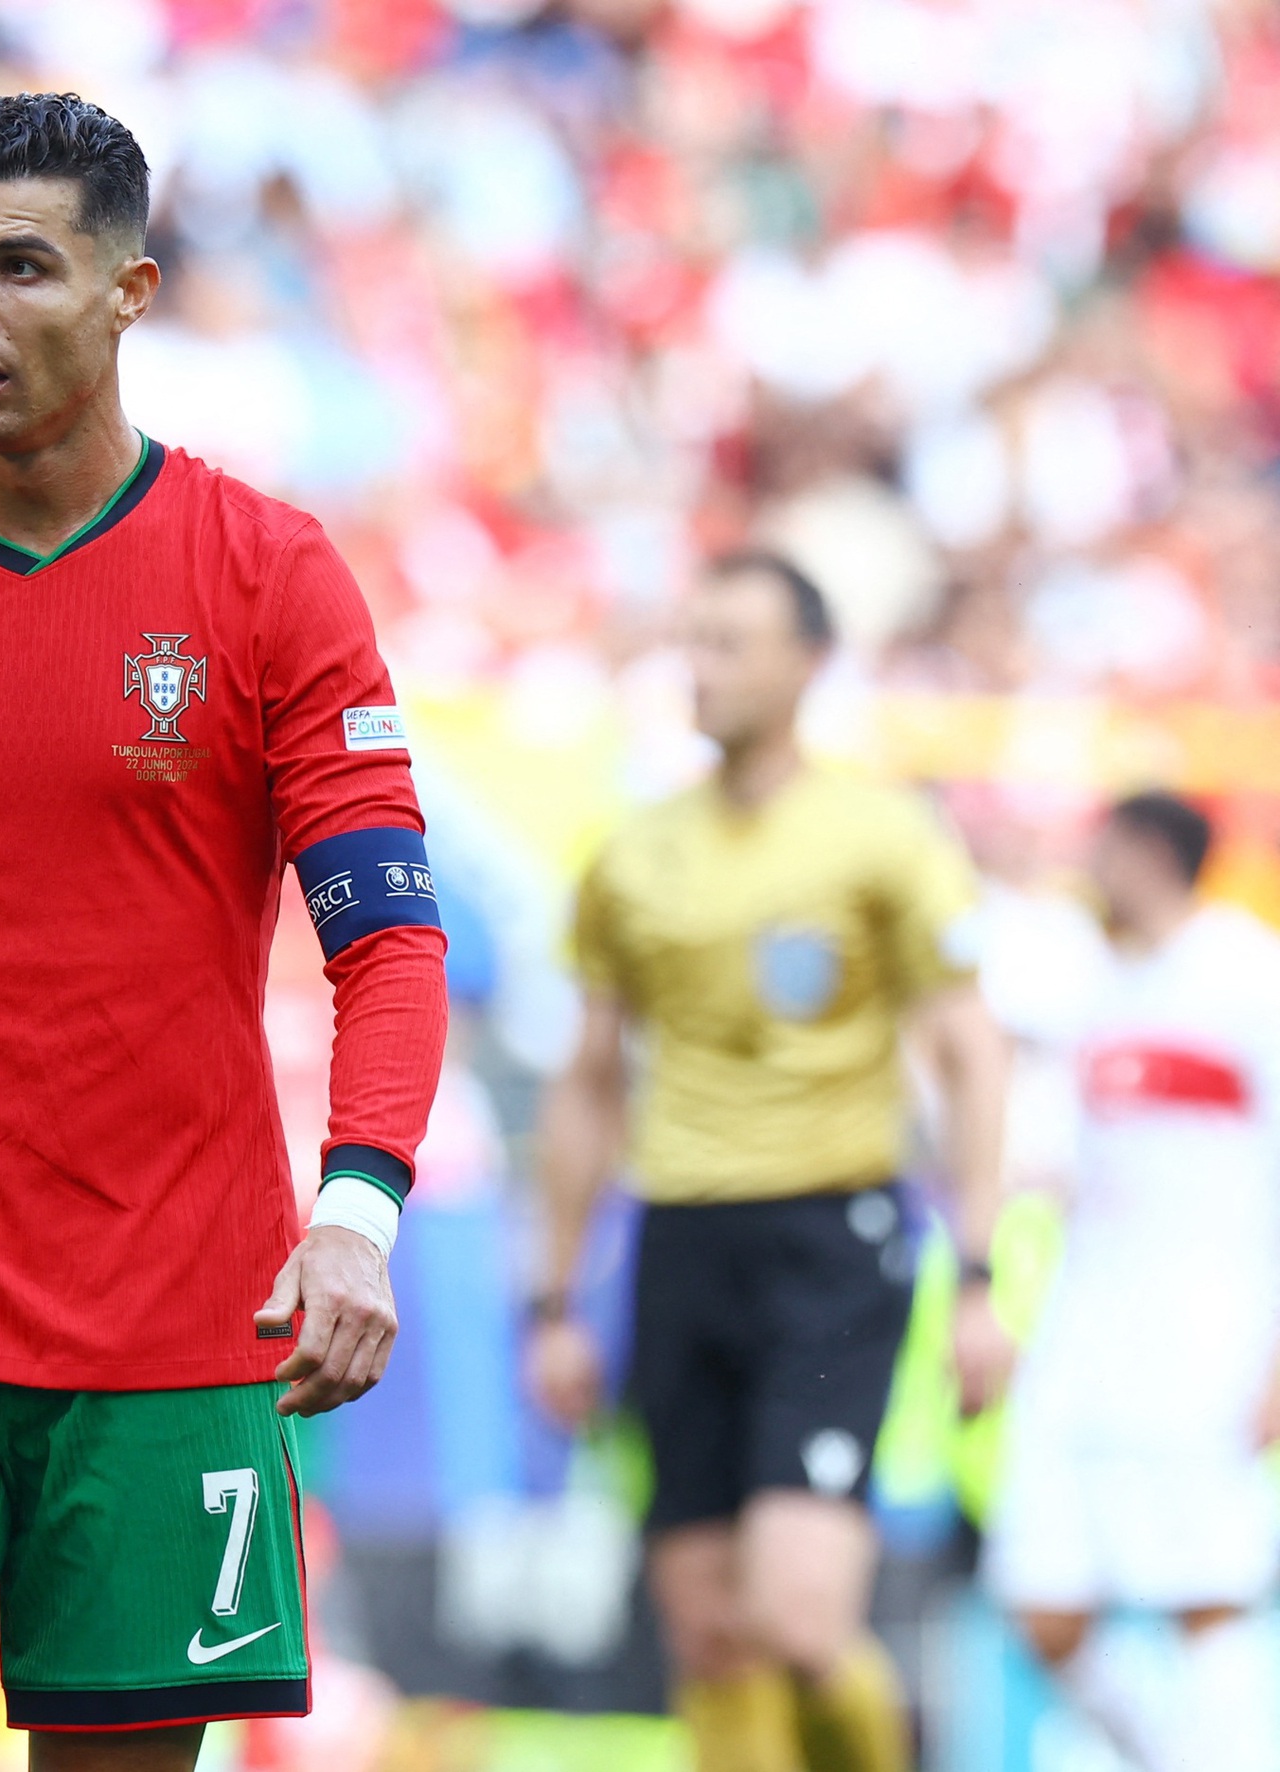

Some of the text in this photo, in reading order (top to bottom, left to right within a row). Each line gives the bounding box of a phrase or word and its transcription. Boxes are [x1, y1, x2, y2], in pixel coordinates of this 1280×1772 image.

[346, 710, 371, 720] UEFA
[126, 758, 198, 771] 22 JUNHO 2024
[136, 770, 188, 782] DORTMUND
[413, 871, 436, 895] RE
[202, 1467, 259, 1616] 7
